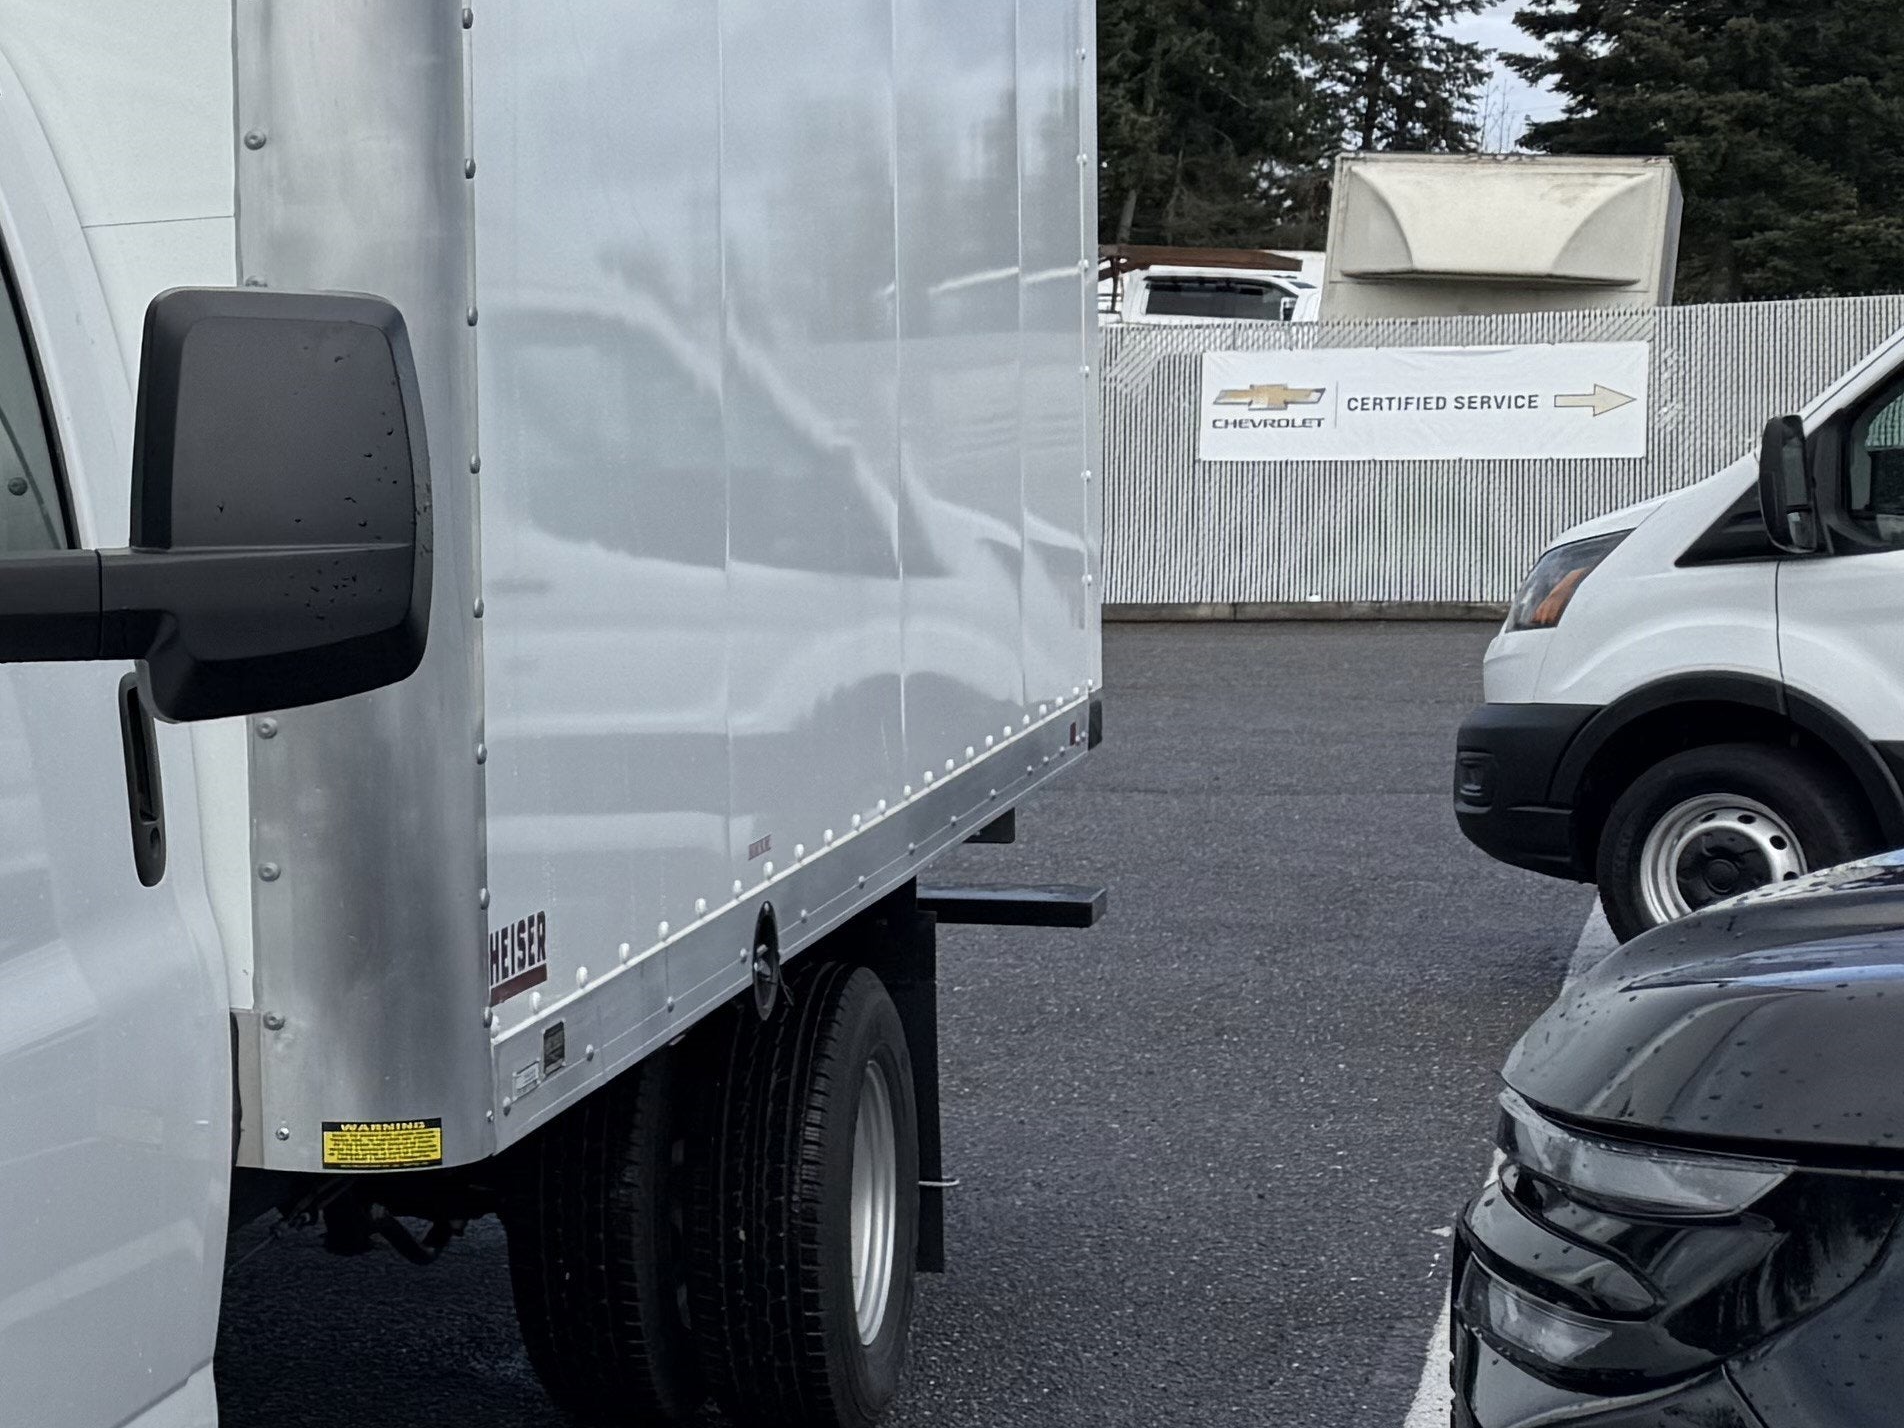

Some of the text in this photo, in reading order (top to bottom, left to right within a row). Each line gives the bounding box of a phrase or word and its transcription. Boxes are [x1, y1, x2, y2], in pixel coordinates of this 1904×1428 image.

[1346, 394, 1539, 412] CERTIFIED SERVICE
[1211, 416, 1325, 430] CHEVROLET
[490, 910, 546, 986] HEISER
